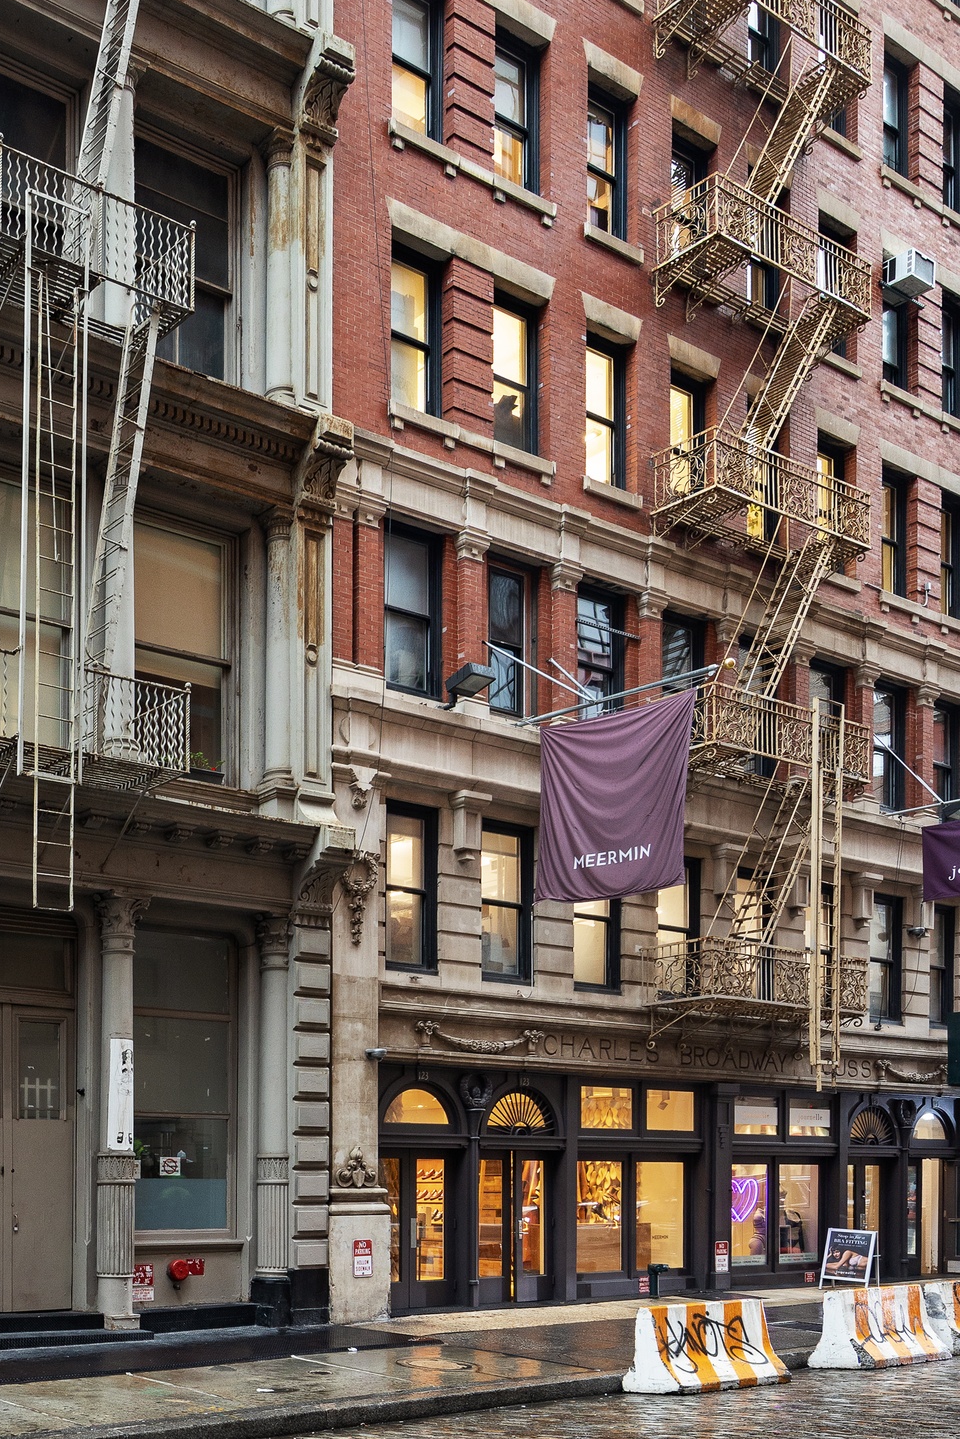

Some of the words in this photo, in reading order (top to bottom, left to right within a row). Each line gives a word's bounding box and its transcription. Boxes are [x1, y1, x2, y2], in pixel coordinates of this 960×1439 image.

[573, 843, 651, 870] MEERMIN
[543, 1034, 659, 1063] CHARLES
[680, 1045, 788, 1073] BROADWAY
[418, 1071, 429, 1080] 123
